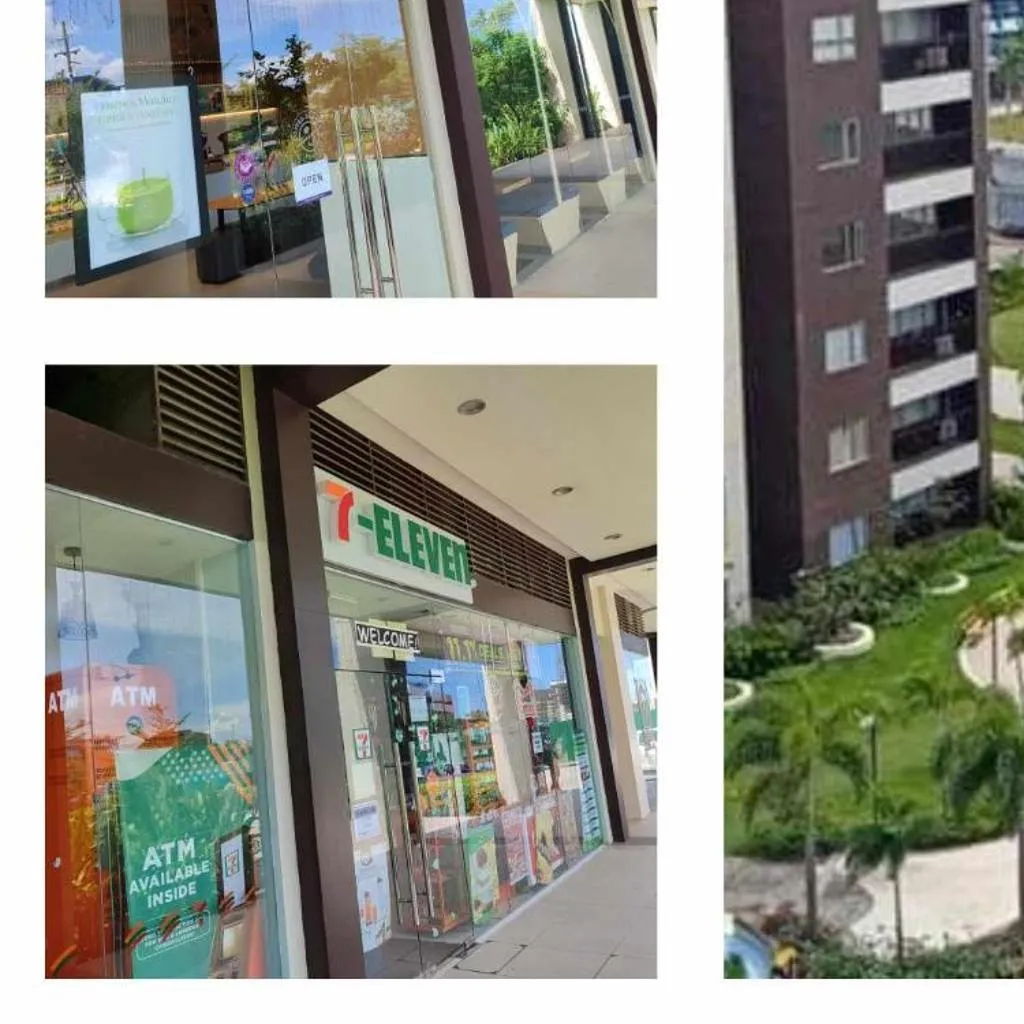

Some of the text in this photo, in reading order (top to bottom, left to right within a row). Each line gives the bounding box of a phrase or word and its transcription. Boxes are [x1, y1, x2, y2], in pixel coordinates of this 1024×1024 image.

[301, 173, 323, 187] OPEN
[48, 687, 79, 714] ATM
[110, 685, 157, 708] ATM
[142, 837, 196, 872] ATM
[129, 860, 210, 895] AVAILABLE
[147, 881, 197, 909] INSIDE
